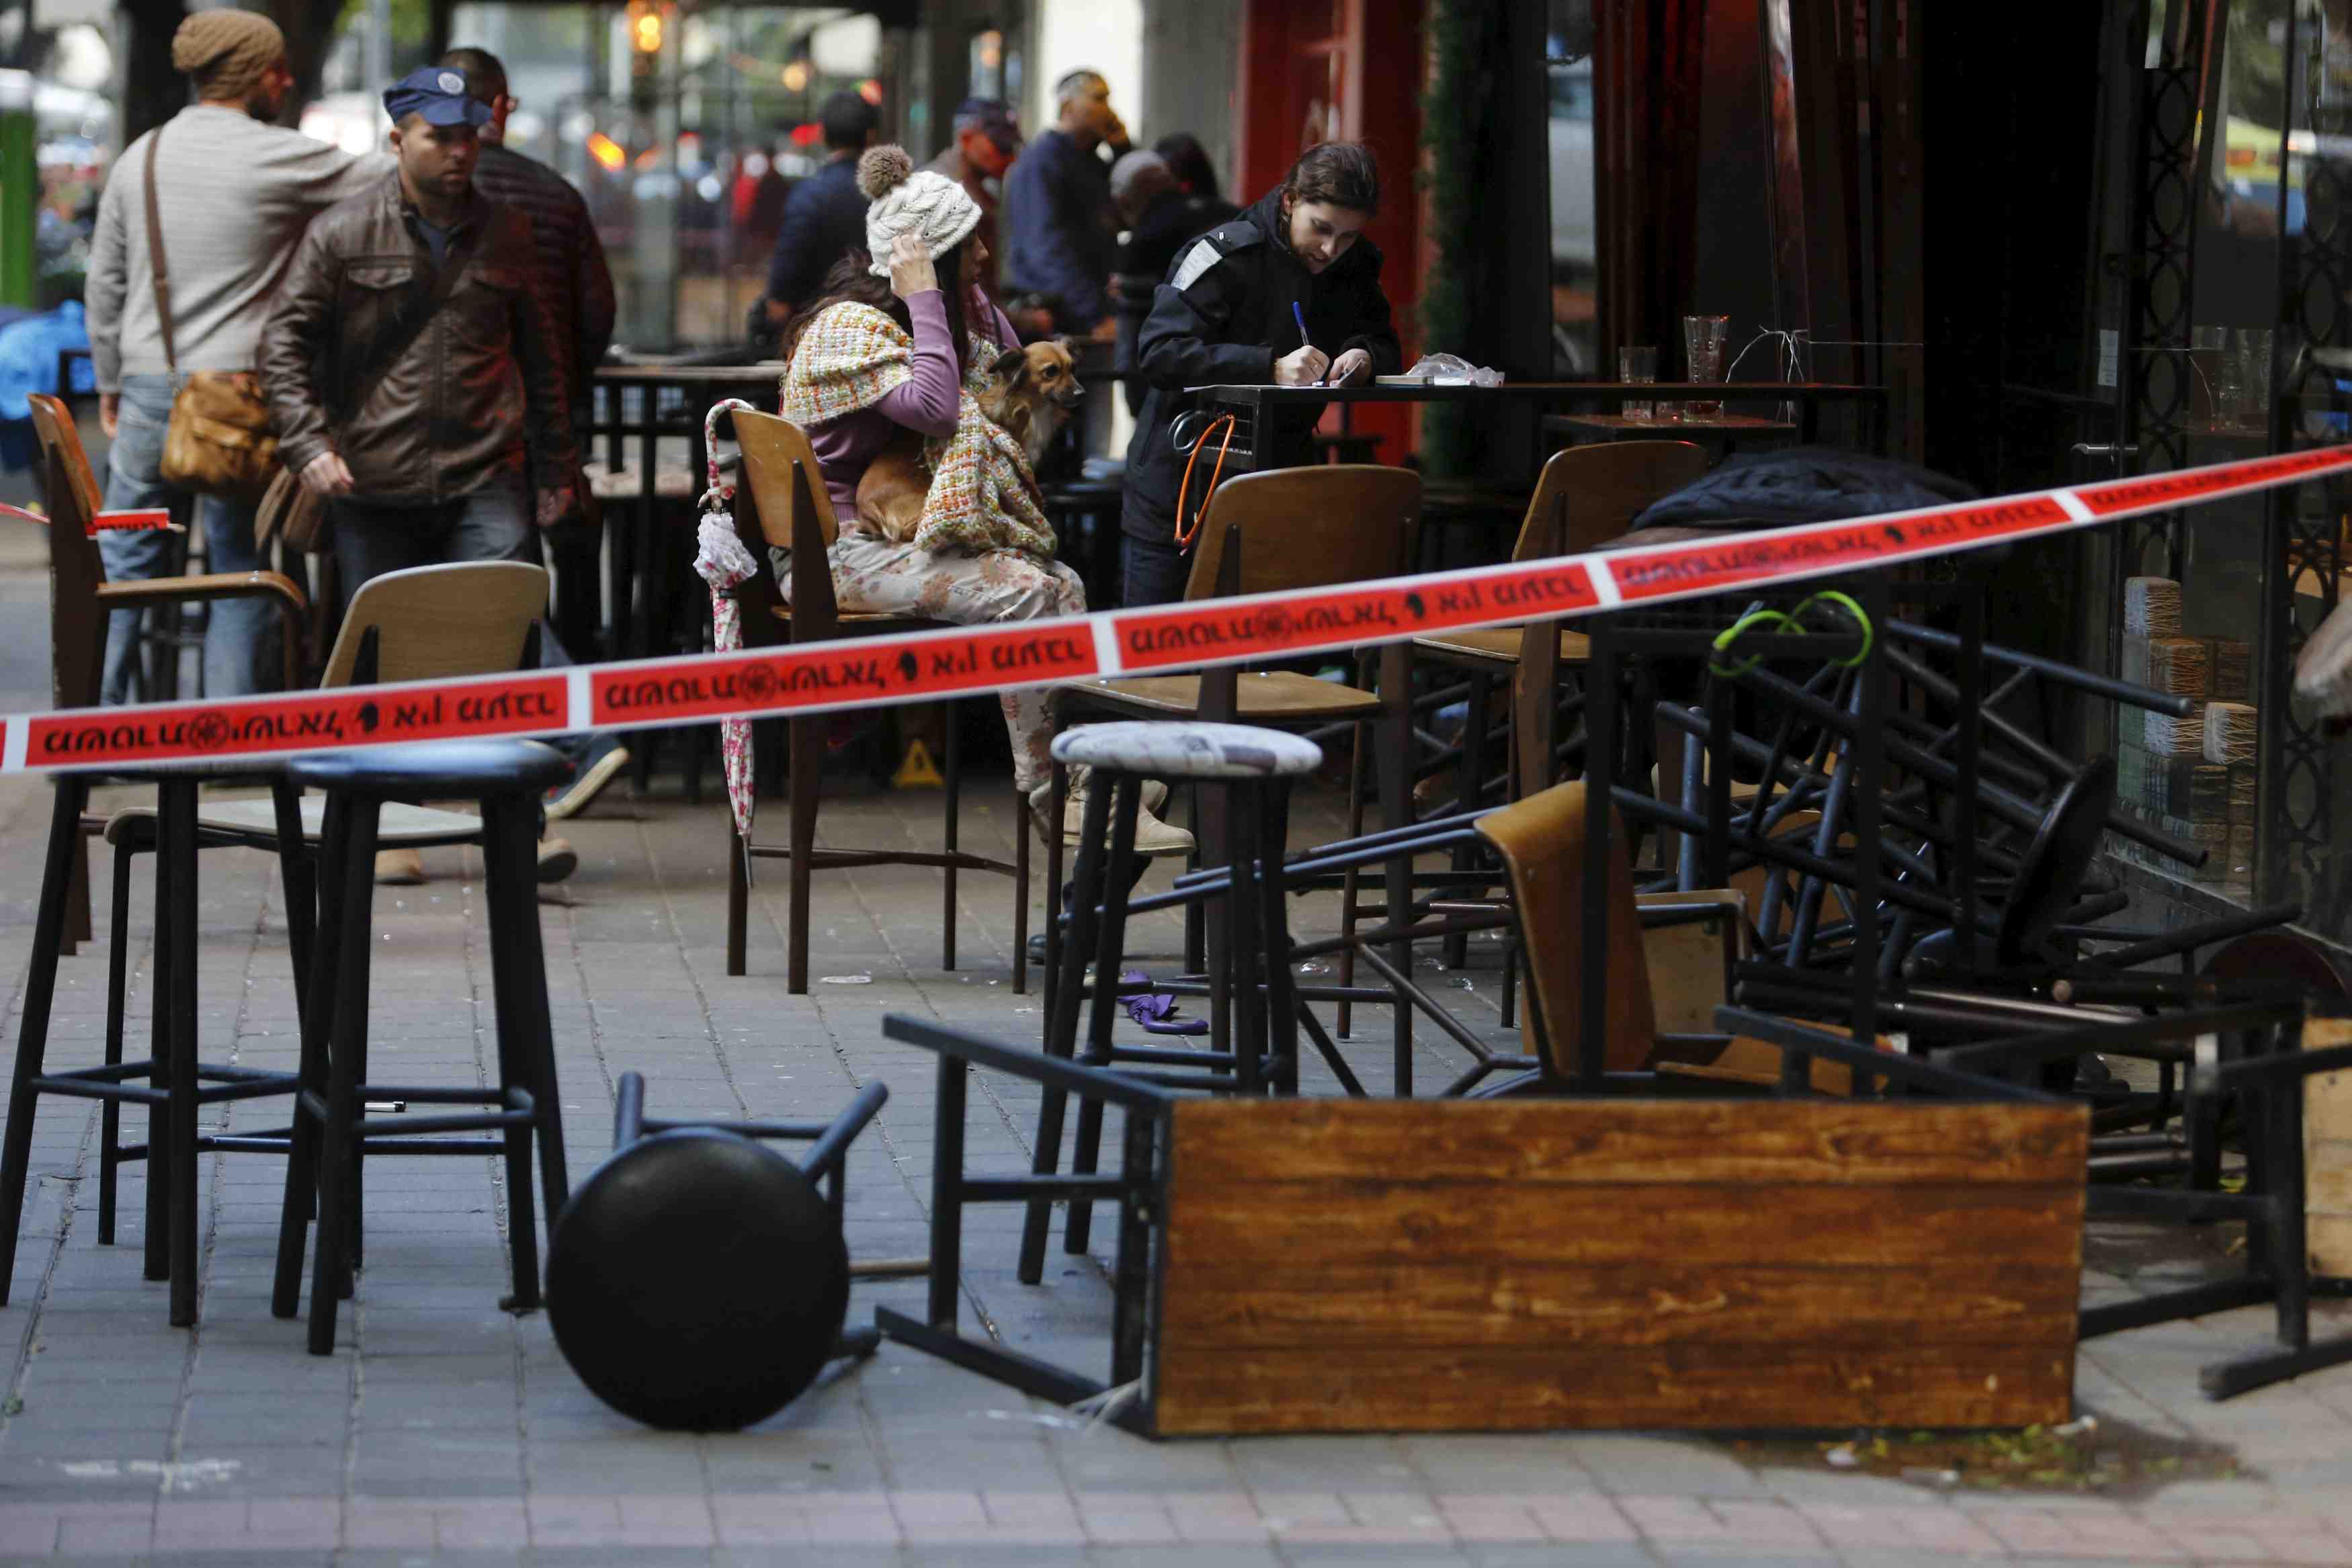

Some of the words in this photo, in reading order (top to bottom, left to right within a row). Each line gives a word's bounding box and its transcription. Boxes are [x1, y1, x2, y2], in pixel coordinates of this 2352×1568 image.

[1130, 614, 1254, 652] משטרת
[1296, 601, 1397, 629] ישראל
[1438, 582, 1483, 613] אין
[1493, 576, 1584, 602] מעבר
[605, 674, 737, 709] משטרת
[780, 659, 886, 688] ישראל
[932, 642, 978, 674] אין
[992, 638, 1083, 668] מעבר
[44, 721, 187, 753] משטרת
[231, 710, 343, 742] ישראל
[394, 695, 442, 726] אין
[458, 691, 558, 720] מעבר
